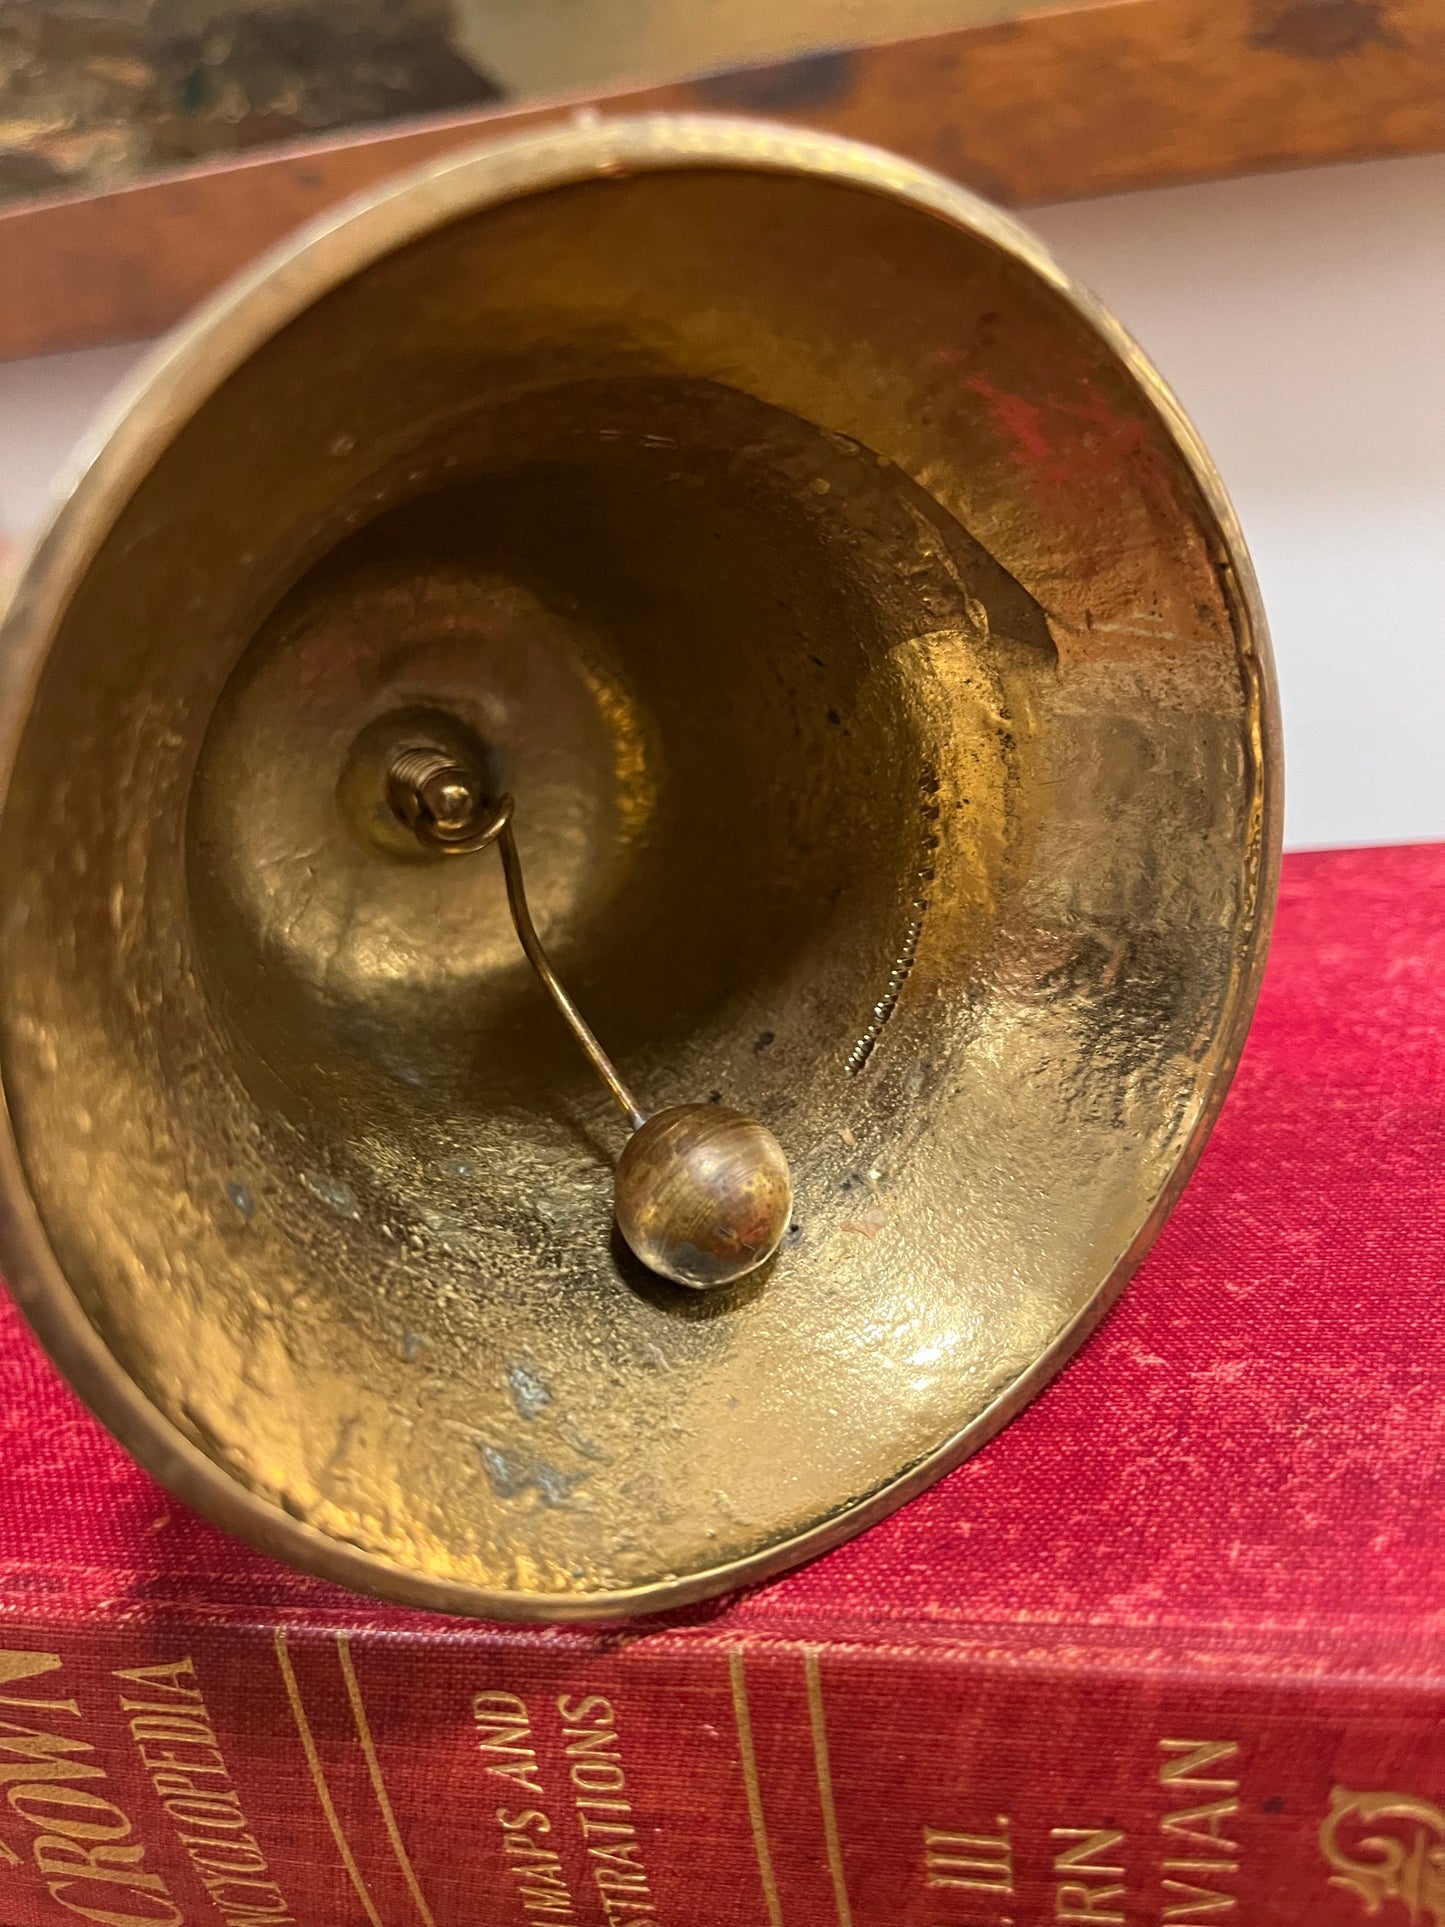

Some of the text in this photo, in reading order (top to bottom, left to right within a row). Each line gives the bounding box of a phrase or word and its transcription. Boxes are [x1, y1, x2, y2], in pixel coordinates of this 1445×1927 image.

[0, 1650, 184, 1927] CROWN
[472, 1690, 544, 1793] AND
[496, 1808, 577, 1914] MAPS
[1157, 1739, 1240, 1927] VIAN
